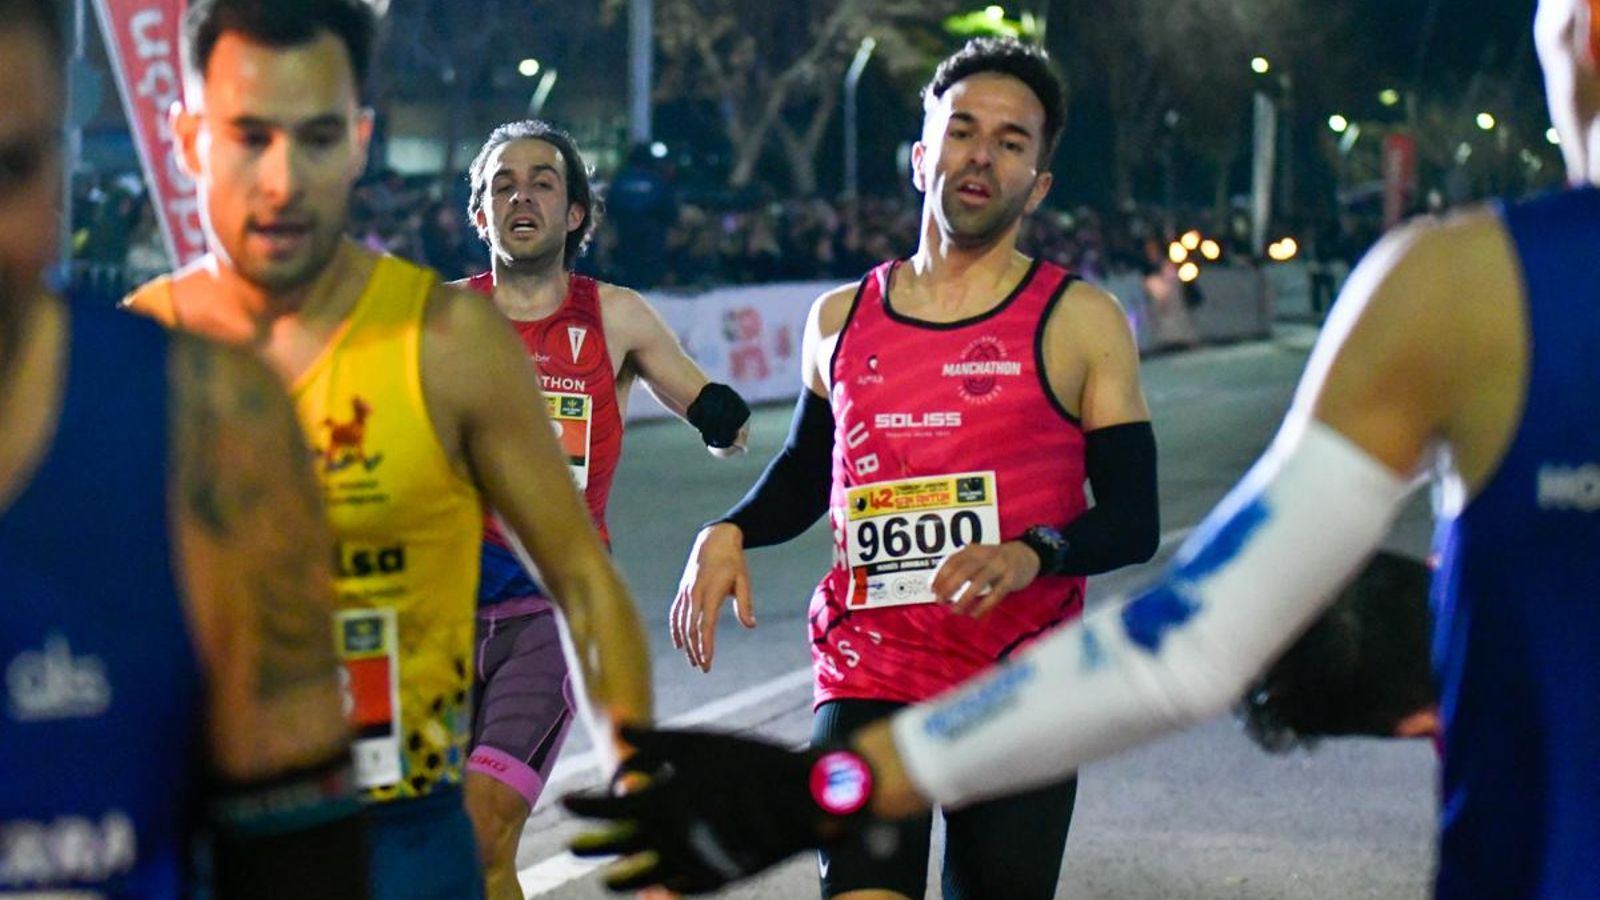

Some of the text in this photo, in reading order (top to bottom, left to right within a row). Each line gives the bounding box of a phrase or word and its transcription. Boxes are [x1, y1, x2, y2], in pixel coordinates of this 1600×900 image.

[942, 361, 1022, 377] MANCHATHON
[536, 375, 586, 391] THON
[874, 411, 962, 429] SOLISS
[869, 488, 894, 510] 42
[857, 510, 983, 562] 9600
